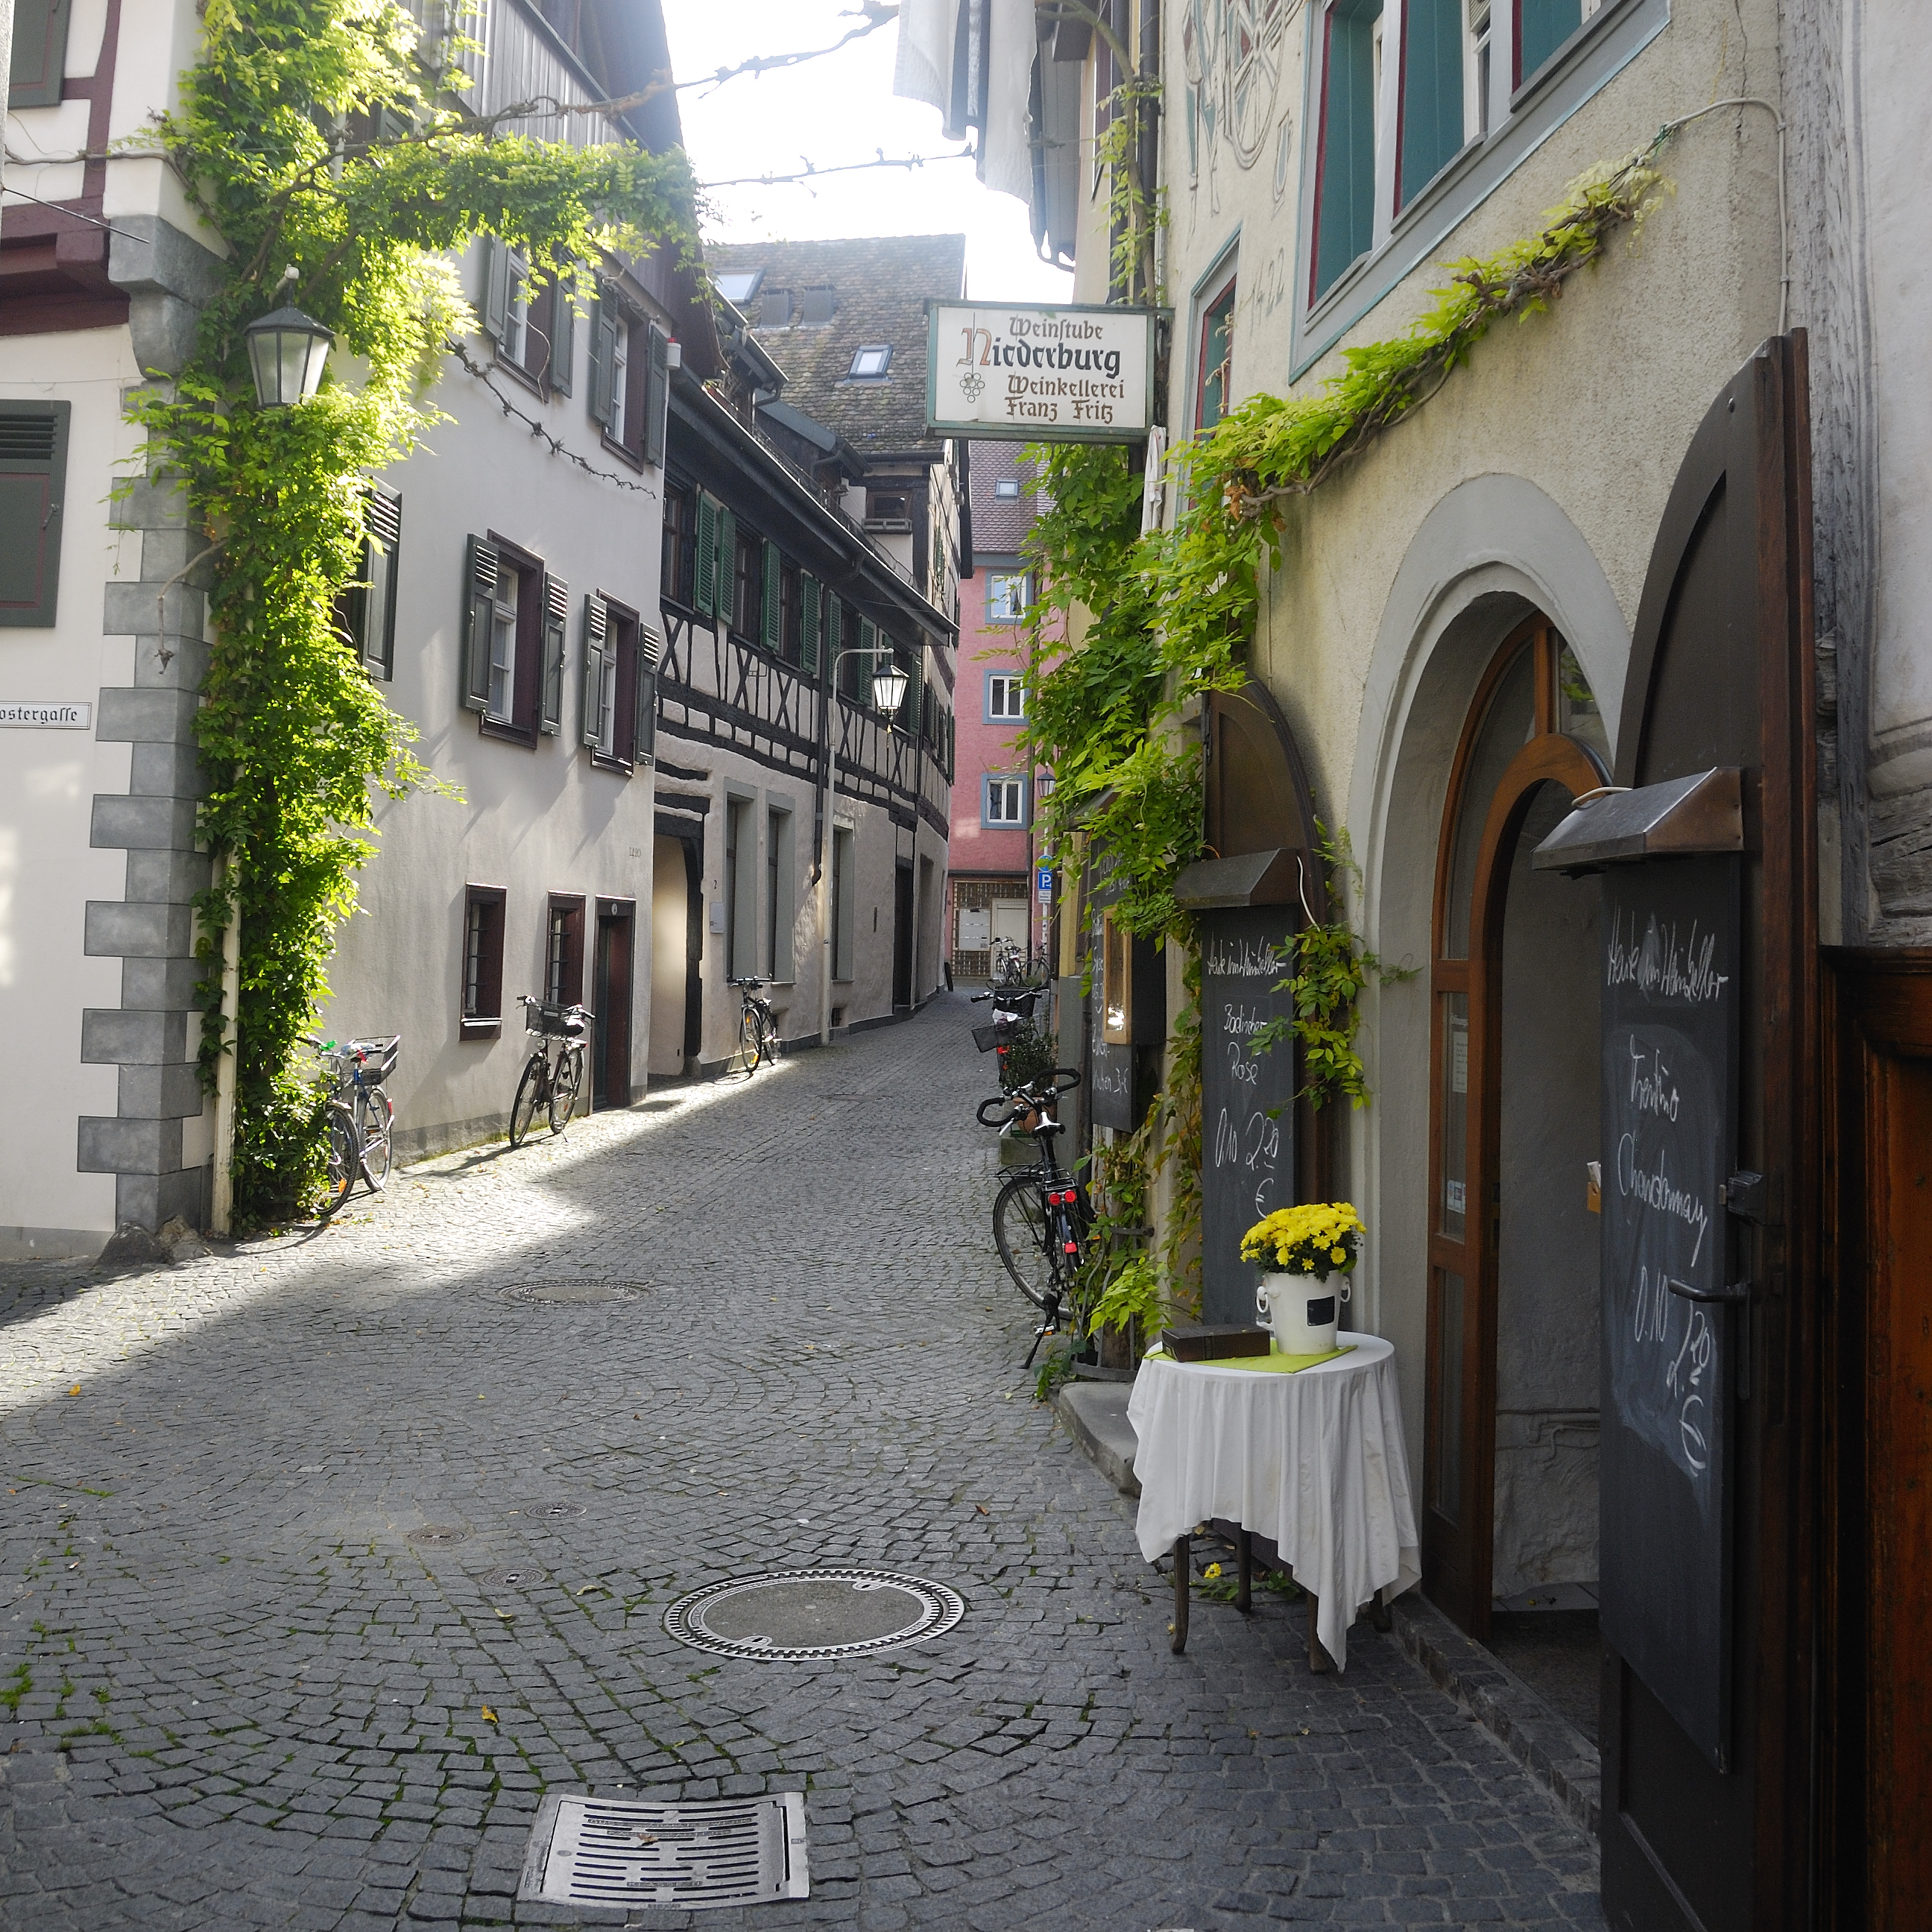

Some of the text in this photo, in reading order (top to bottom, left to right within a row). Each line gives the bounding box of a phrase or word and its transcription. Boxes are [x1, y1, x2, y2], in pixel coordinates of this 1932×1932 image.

[956, 326, 1120, 379] Niederburg
[1008, 372, 1124, 399] Weinkellerei
[1005, 396, 1114, 424] Franz Fritz
[1041, 874, 1051, 888] P
